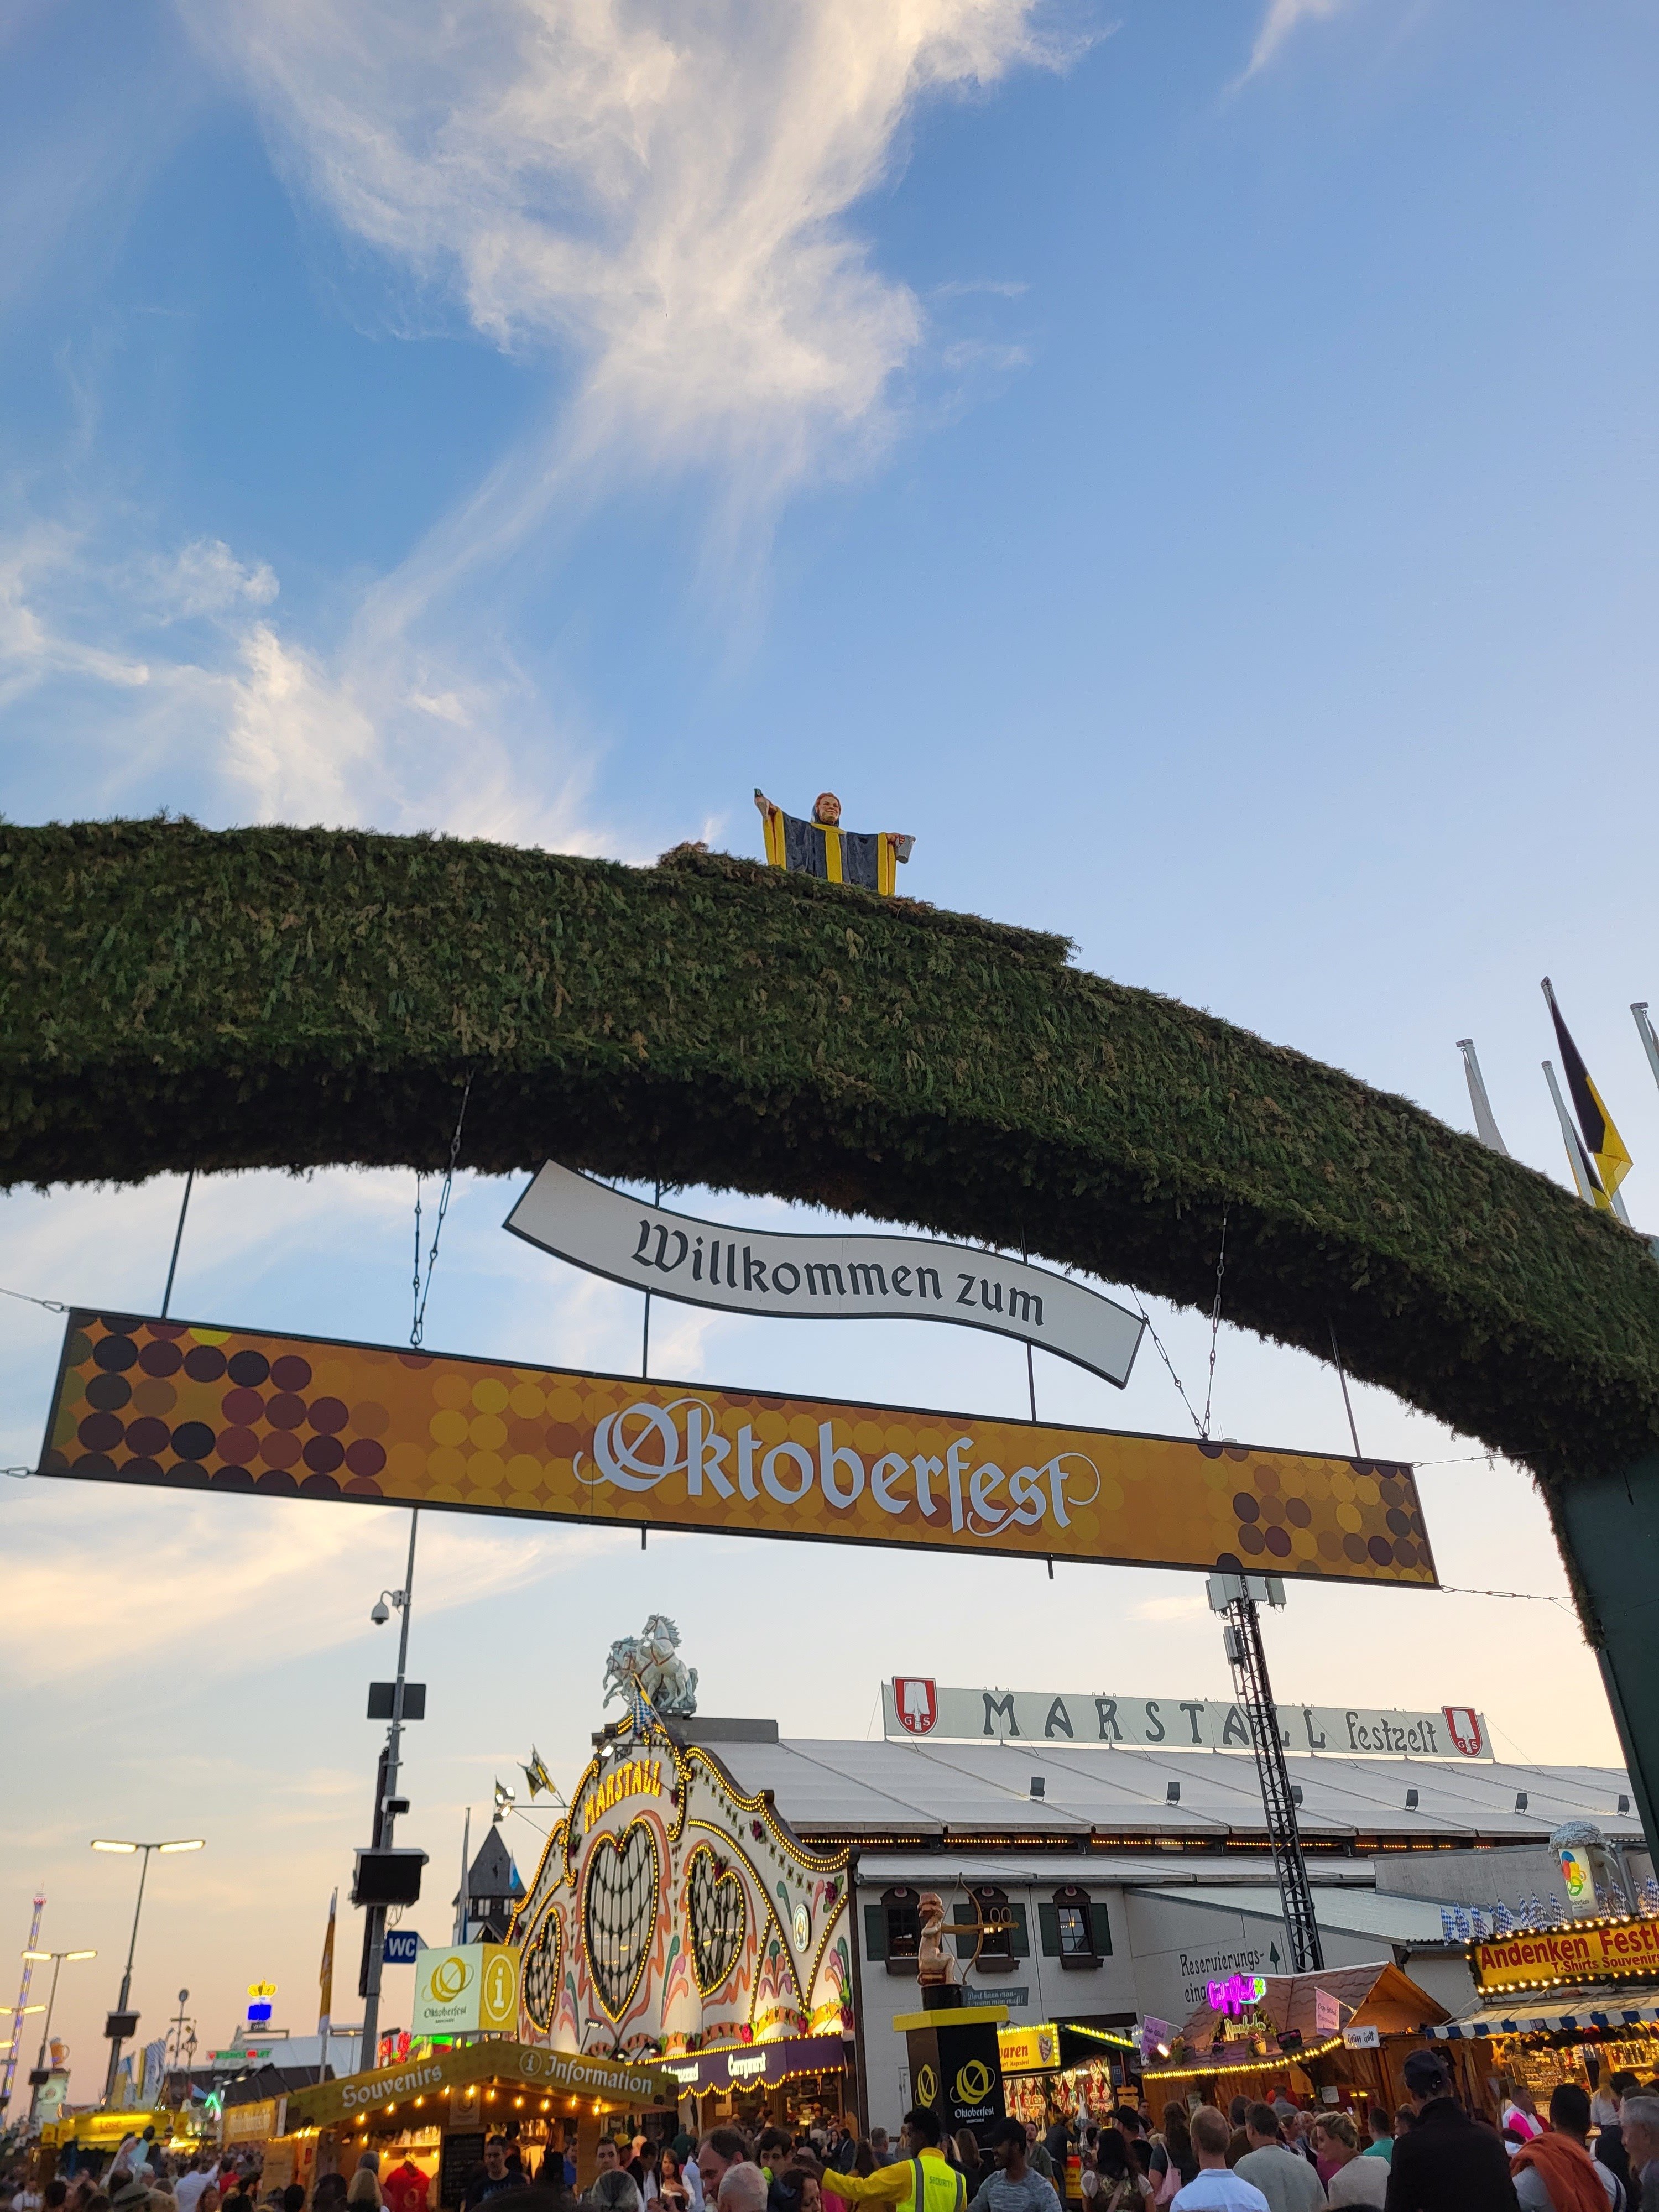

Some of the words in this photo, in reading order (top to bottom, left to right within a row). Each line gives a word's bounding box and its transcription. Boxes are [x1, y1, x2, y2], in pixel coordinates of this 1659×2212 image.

[632, 1219, 941, 1301] Willkommen
[956, 1272, 1044, 1326] zum
[573, 1397, 1100, 1537] Oktoberfest
[583, 1758, 661, 1834] MARSTALL
[388, 1938, 416, 1957] WC
[1180, 1950, 1264, 1976] Reservierungs-
[1481, 1937, 1590, 1970] Andenken
[1551, 1958, 1599, 1974] T-Shirts
[342, 2064, 442, 2107] Souvenirs
[544, 2055, 653, 2095] Information
[954, 2106, 994, 2119] Oktoberfest
